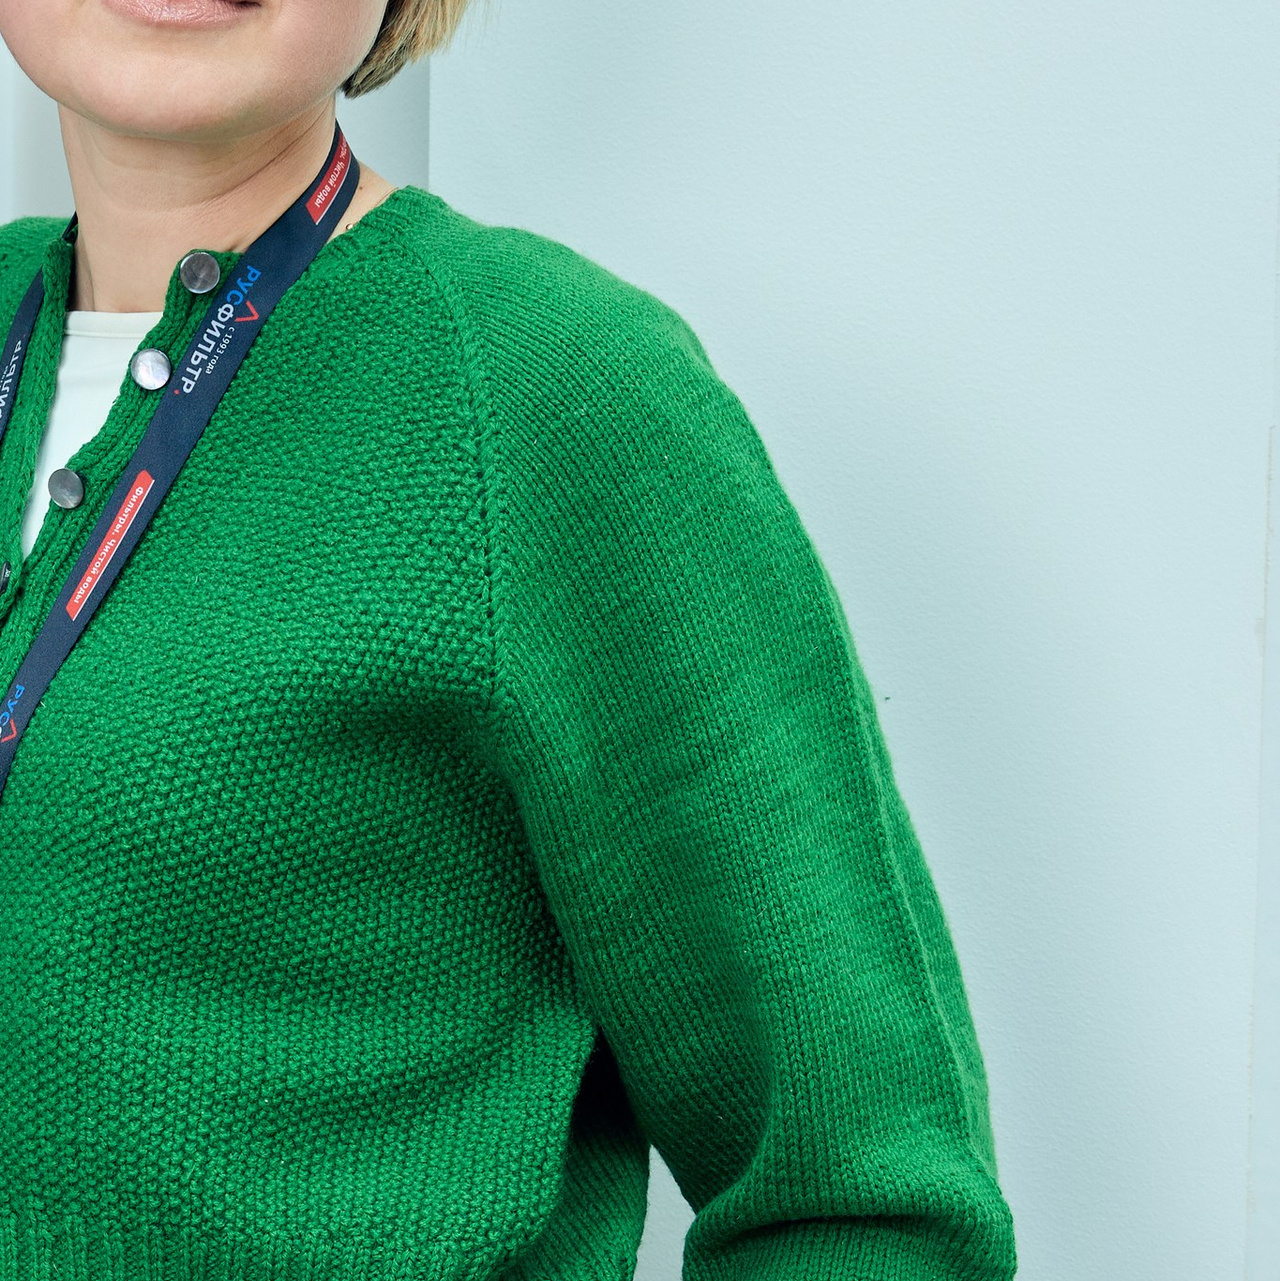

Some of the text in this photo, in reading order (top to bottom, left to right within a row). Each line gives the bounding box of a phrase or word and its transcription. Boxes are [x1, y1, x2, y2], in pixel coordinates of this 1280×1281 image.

[314, 184, 331, 208] воды
[216, 333, 233, 355] 1993
[205, 353, 219, 375] года
[73, 486, 144, 604] Фильтры. Чистой воды
